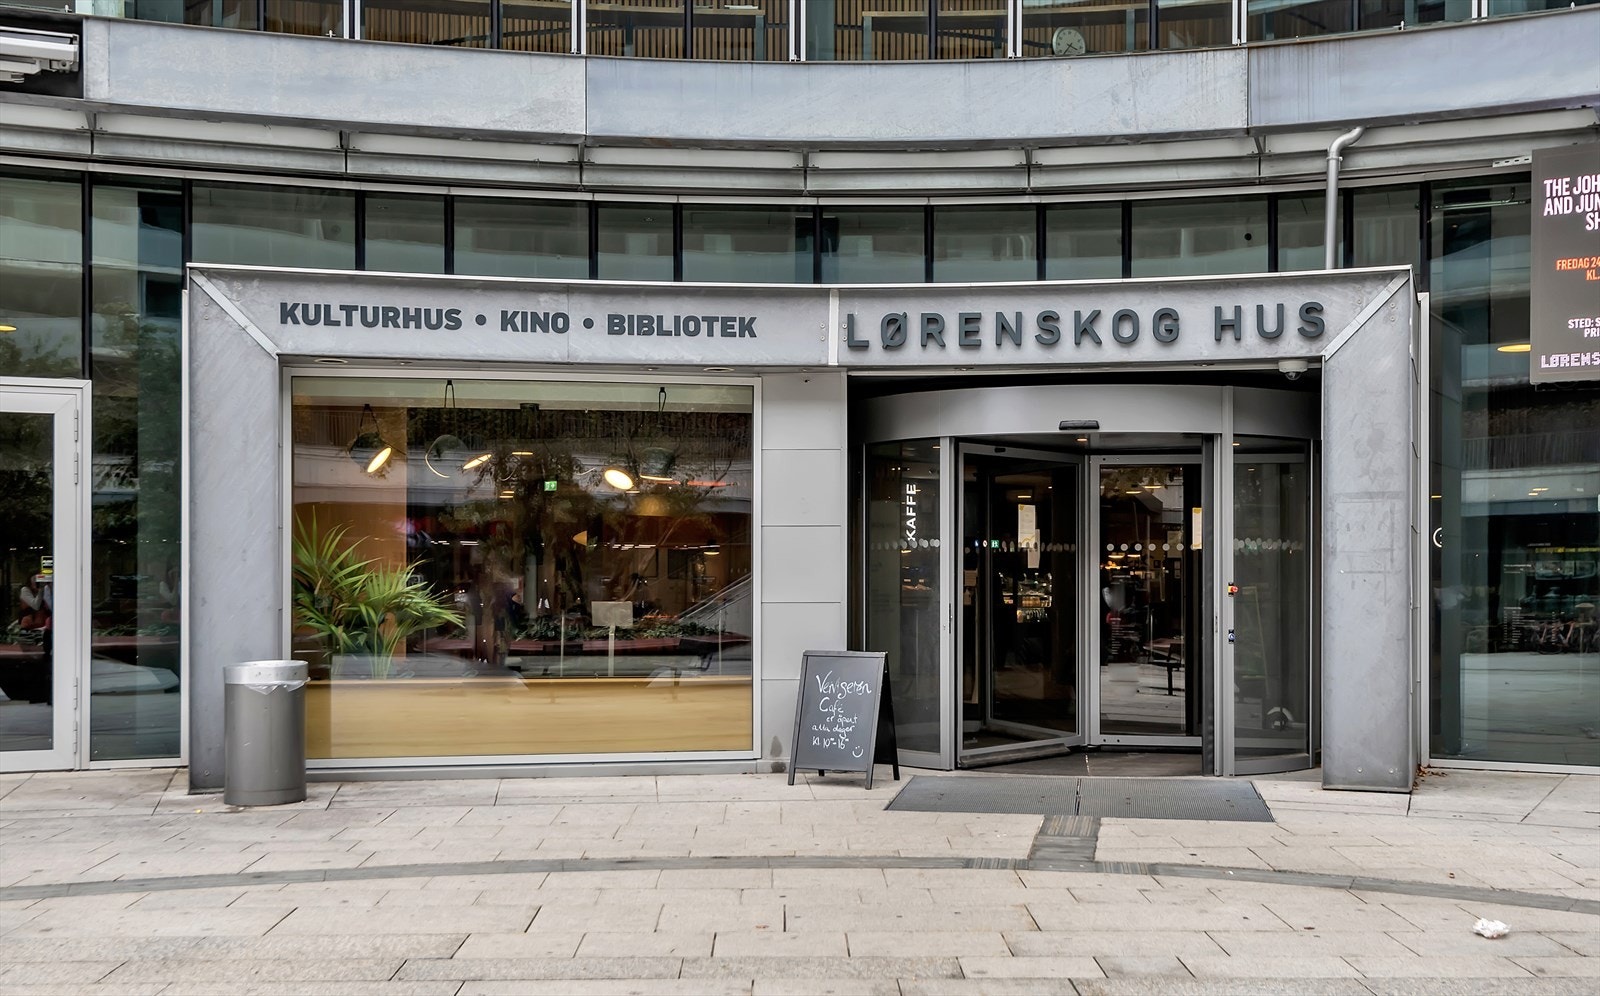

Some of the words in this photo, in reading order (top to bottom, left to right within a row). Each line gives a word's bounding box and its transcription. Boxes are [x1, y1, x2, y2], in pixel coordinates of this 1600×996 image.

[1543, 177, 1570, 198] THE
[1572, 174, 1600, 195] JOH
[1543, 196, 1573, 217] AND
[1556, 257, 1590, 271] FREDAG
[279, 302, 463, 331] KULTURHUS
[500, 310, 570, 334] KINO
[607, 313, 758, 338] BIBLIOTEK
[846, 307, 1181, 350] LØRENSKOG
[1213, 301, 1326, 342] HUS
[1567, 318, 1594, 329] STED:
[905, 483, 917, 542] KAFFE
